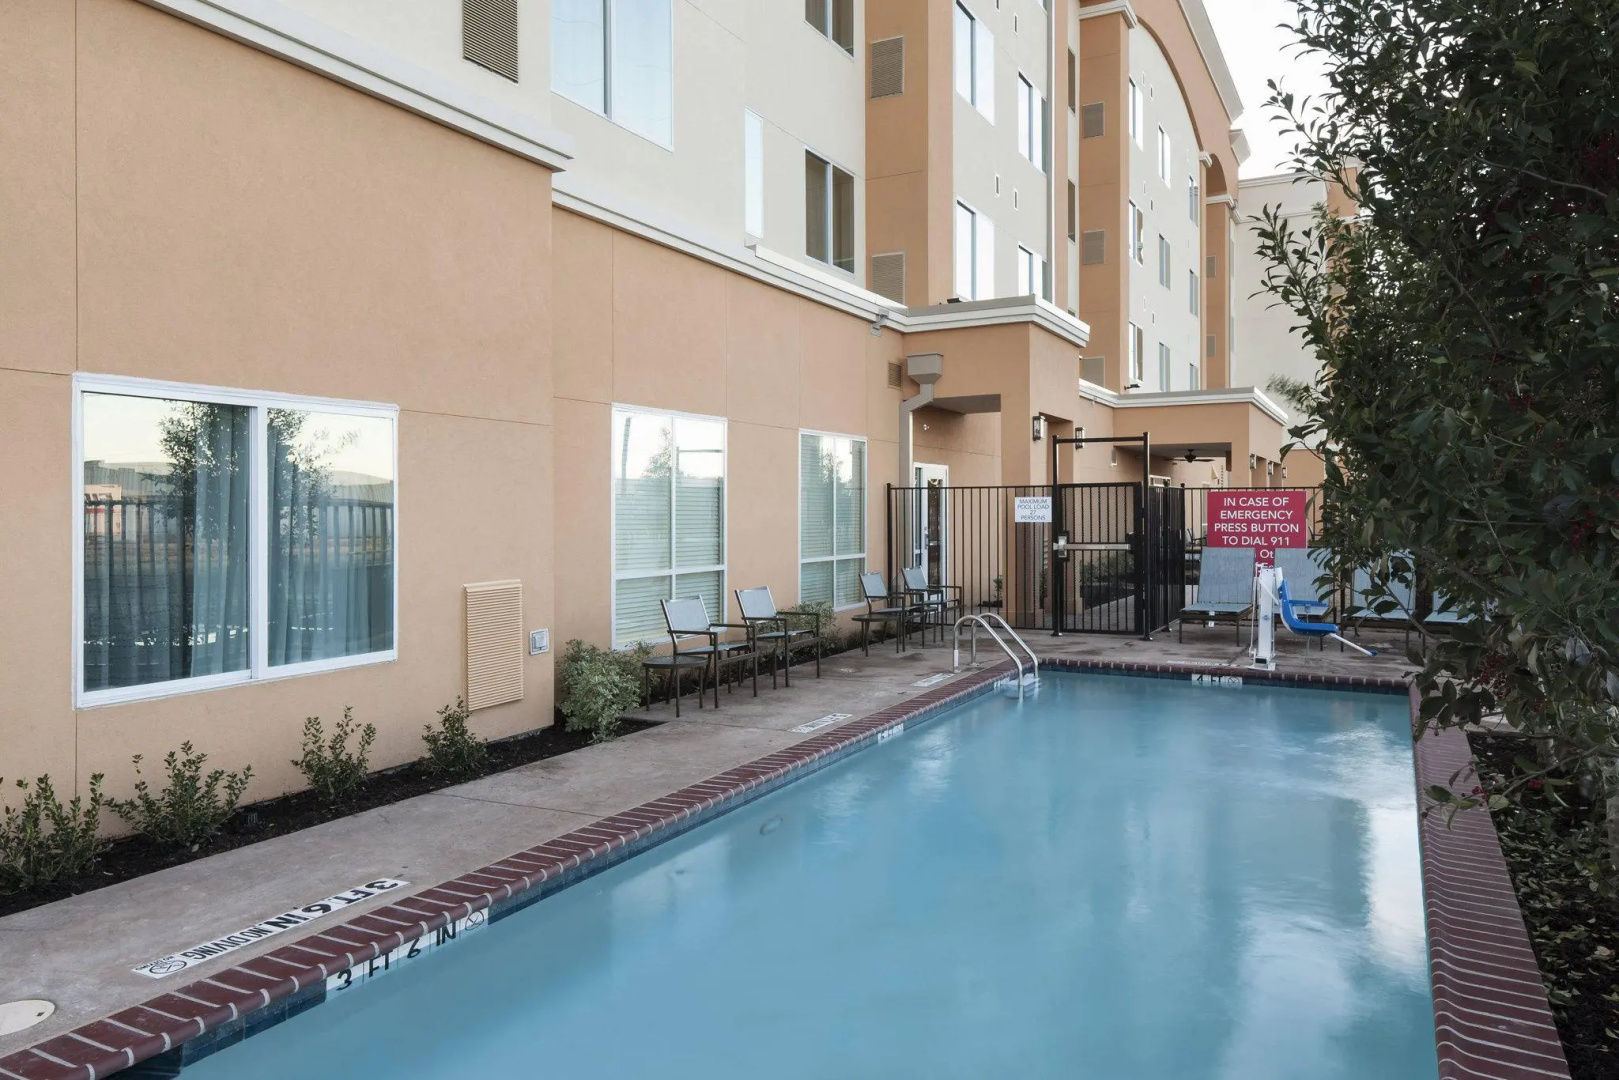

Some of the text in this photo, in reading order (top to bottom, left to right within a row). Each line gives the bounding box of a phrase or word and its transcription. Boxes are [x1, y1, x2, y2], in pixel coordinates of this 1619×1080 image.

[1223, 497, 1289, 507] IN CASE OF
[1220, 510, 1293, 520] EMERGENCY
[1214, 523, 1299, 533] PRESS BUTTON
[1222, 536, 1290, 546] TO DIAL 911
[365, 880, 399, 890] 3
[301, 903, 332, 914] 6
[239, 926, 274, 942] NO
[180, 935, 241, 961] DIVING
[336, 921, 457, 991] 3 FT 6 IN
